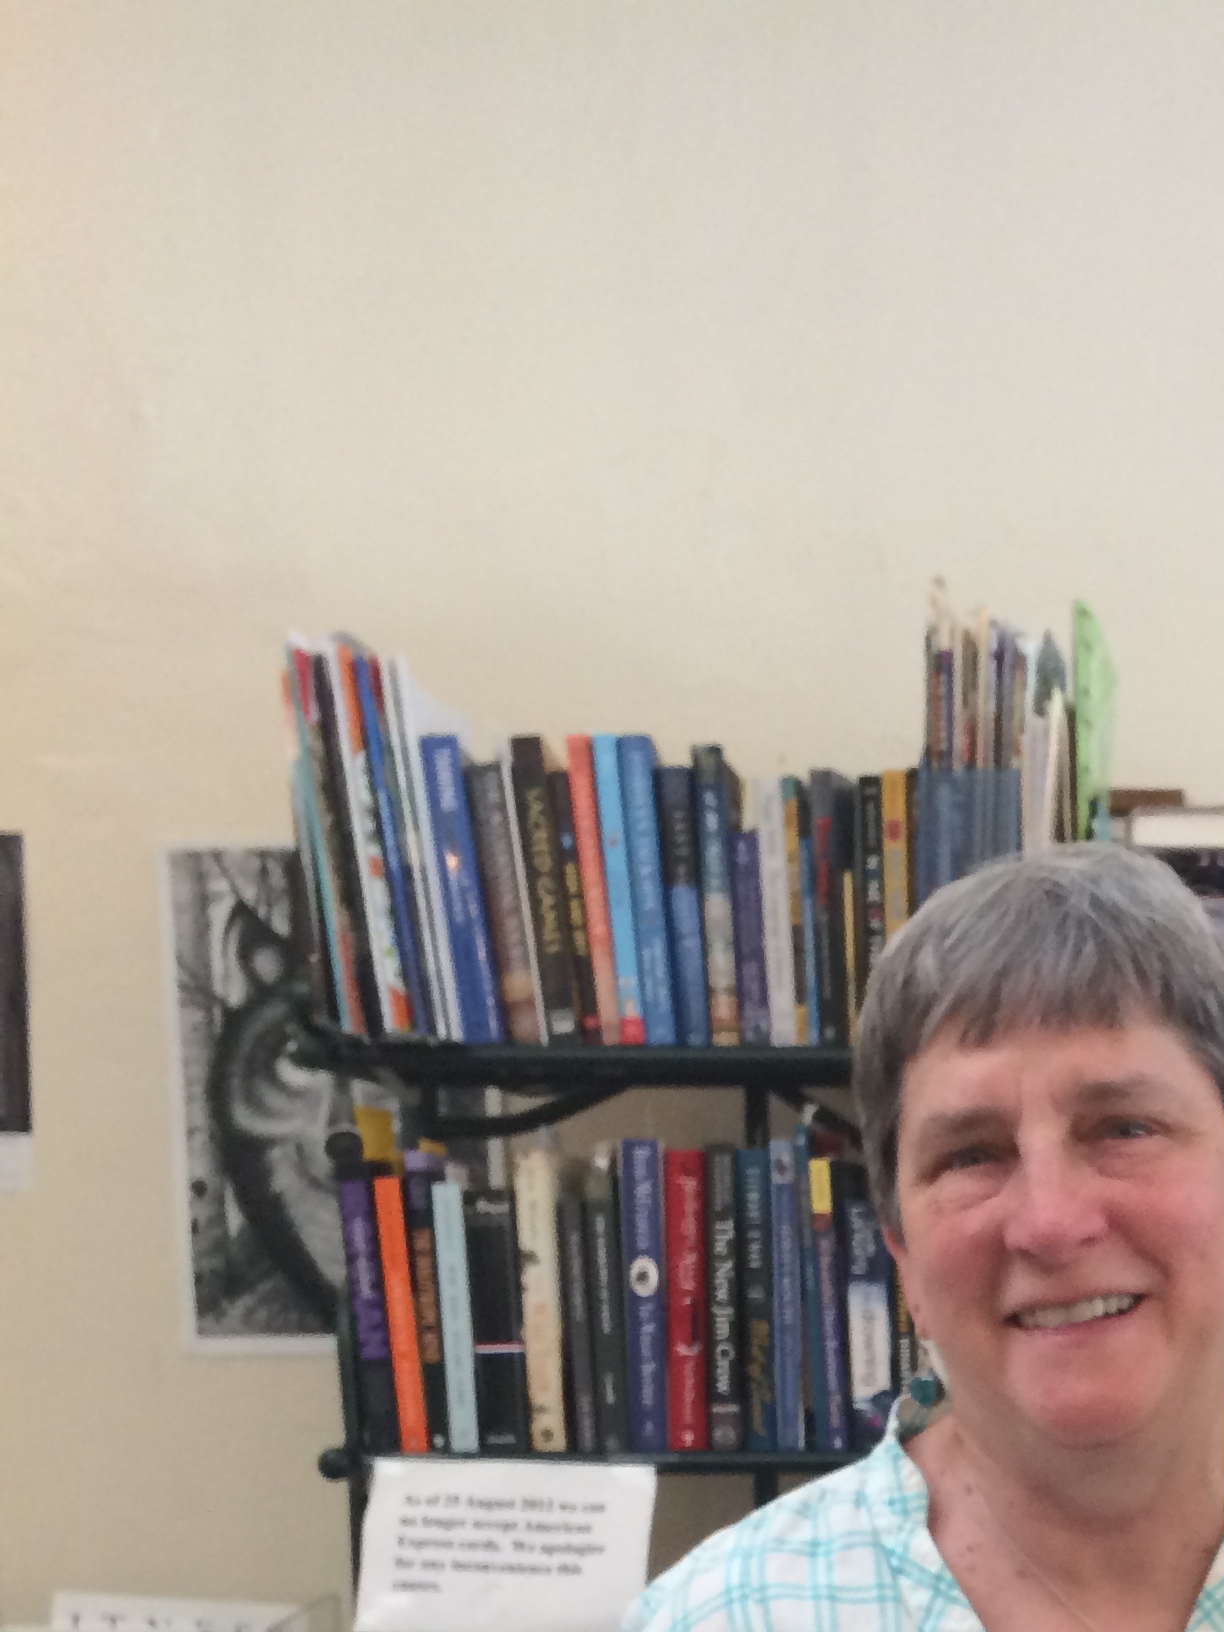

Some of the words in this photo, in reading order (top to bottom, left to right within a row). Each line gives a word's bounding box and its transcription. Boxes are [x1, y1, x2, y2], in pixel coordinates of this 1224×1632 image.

[526, 787, 552, 872] SACRED
[537, 876, 562, 955] GAMES
[712, 1218, 736, 1254] The
[713, 1258, 735, 1304] New
[712, 1304, 735, 1340] Jim
[714, 1341, 736, 1395] Crow
